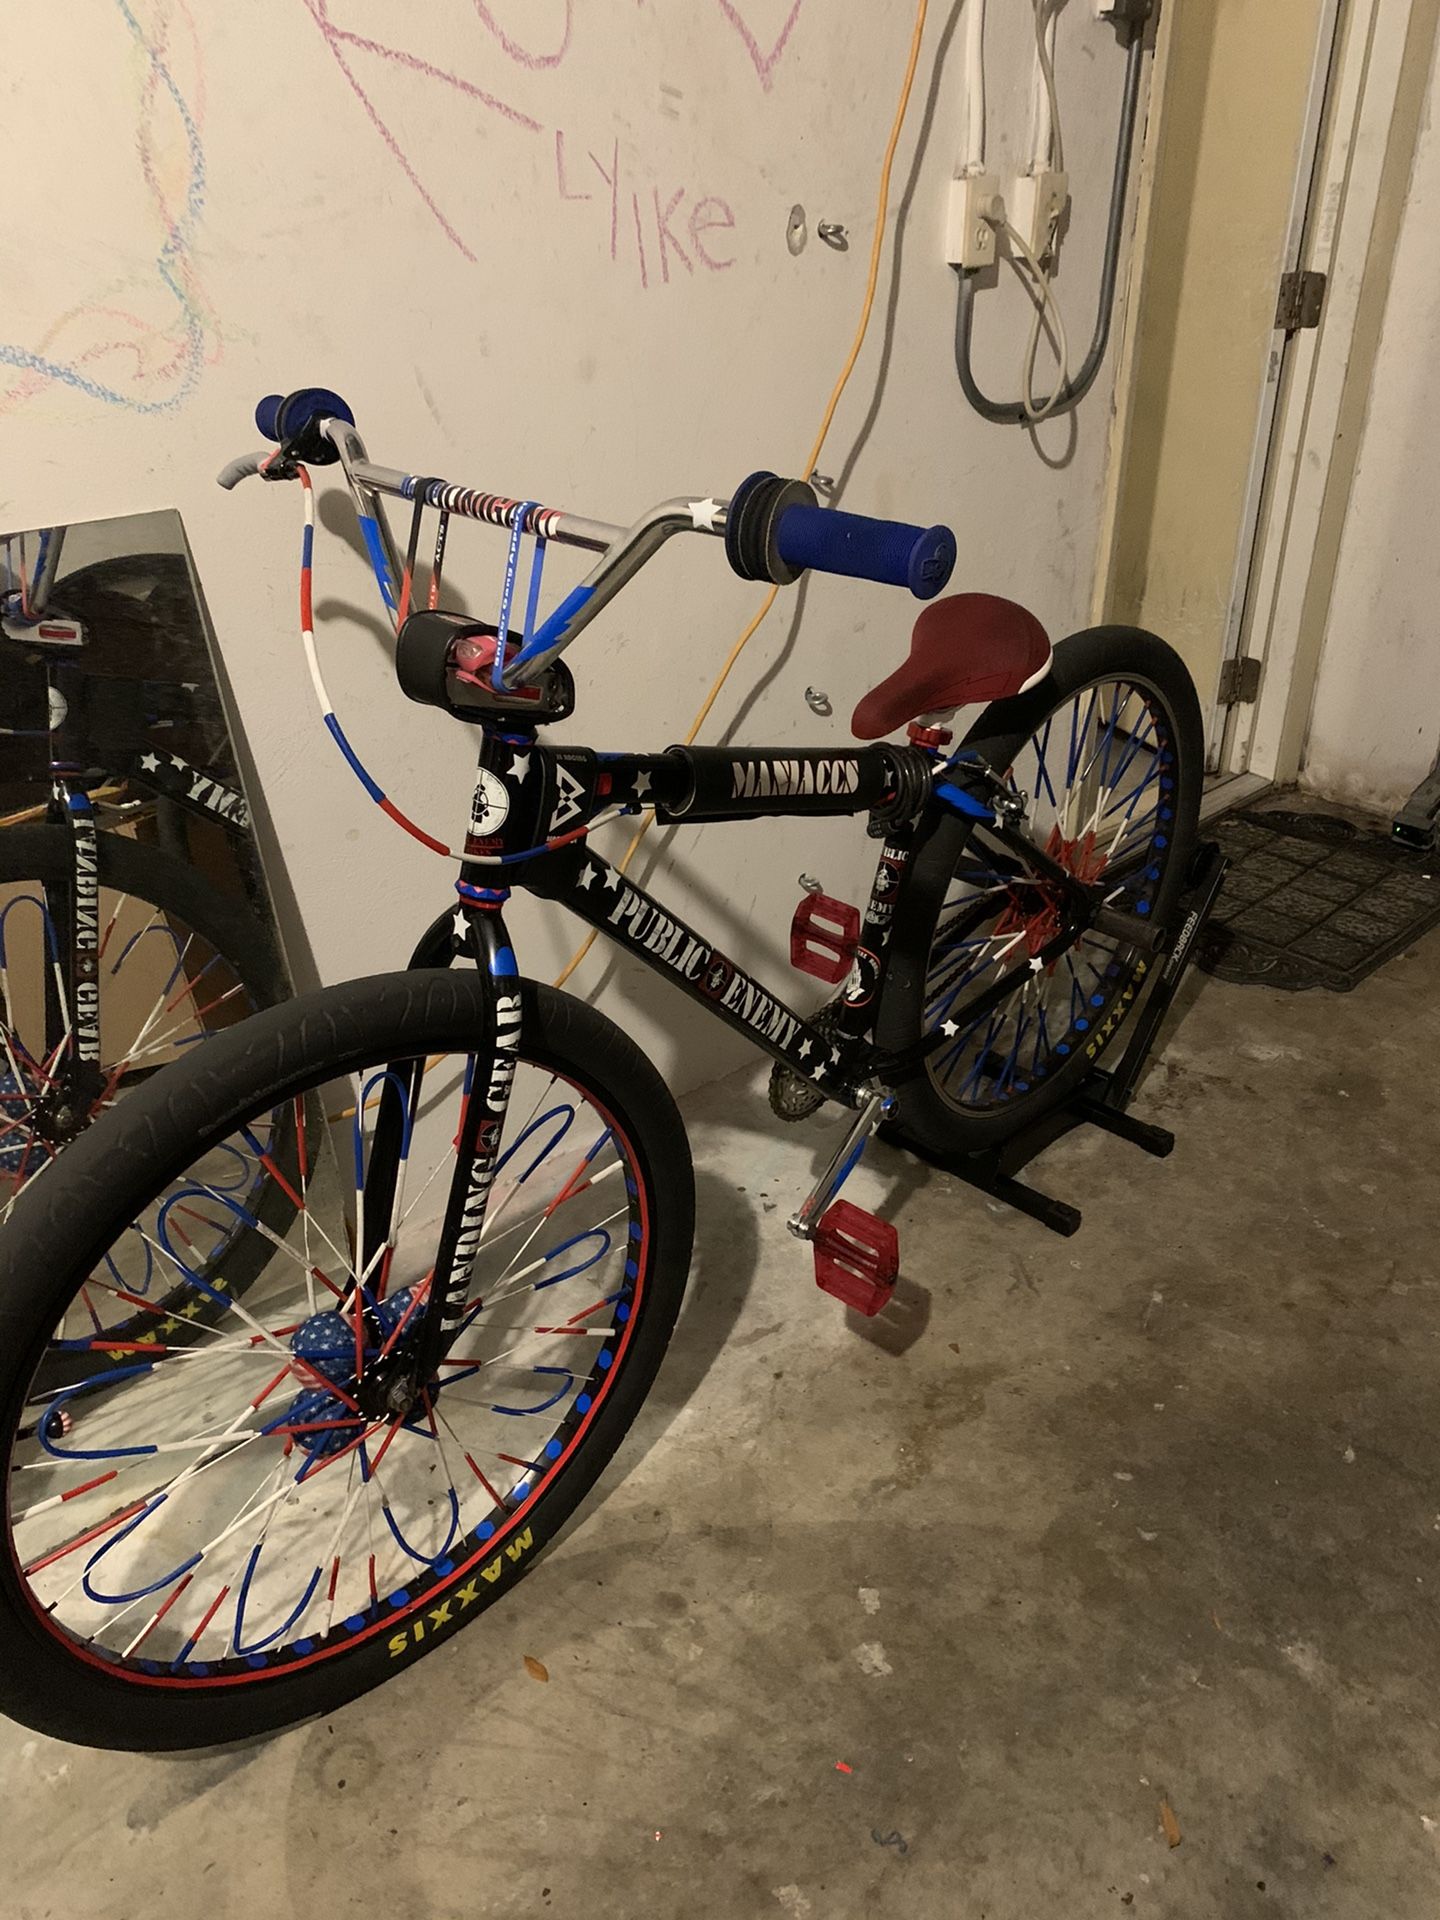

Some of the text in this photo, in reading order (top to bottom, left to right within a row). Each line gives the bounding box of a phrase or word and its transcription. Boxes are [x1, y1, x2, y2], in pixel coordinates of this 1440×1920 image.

[502, 567, 513, 610] Gang
[730, 759, 860, 799] MANIACCS
[882, 845, 910, 862] BLIC
[869, 899, 896, 915] EMY
[1172, 910, 1199, 964] FEEDBACK
[607, 886, 802, 1050] PUBLIC ENEMY
[1086, 959, 1147, 1059] MAXXIS
[388, 1526, 534, 1658] MAXXIS
